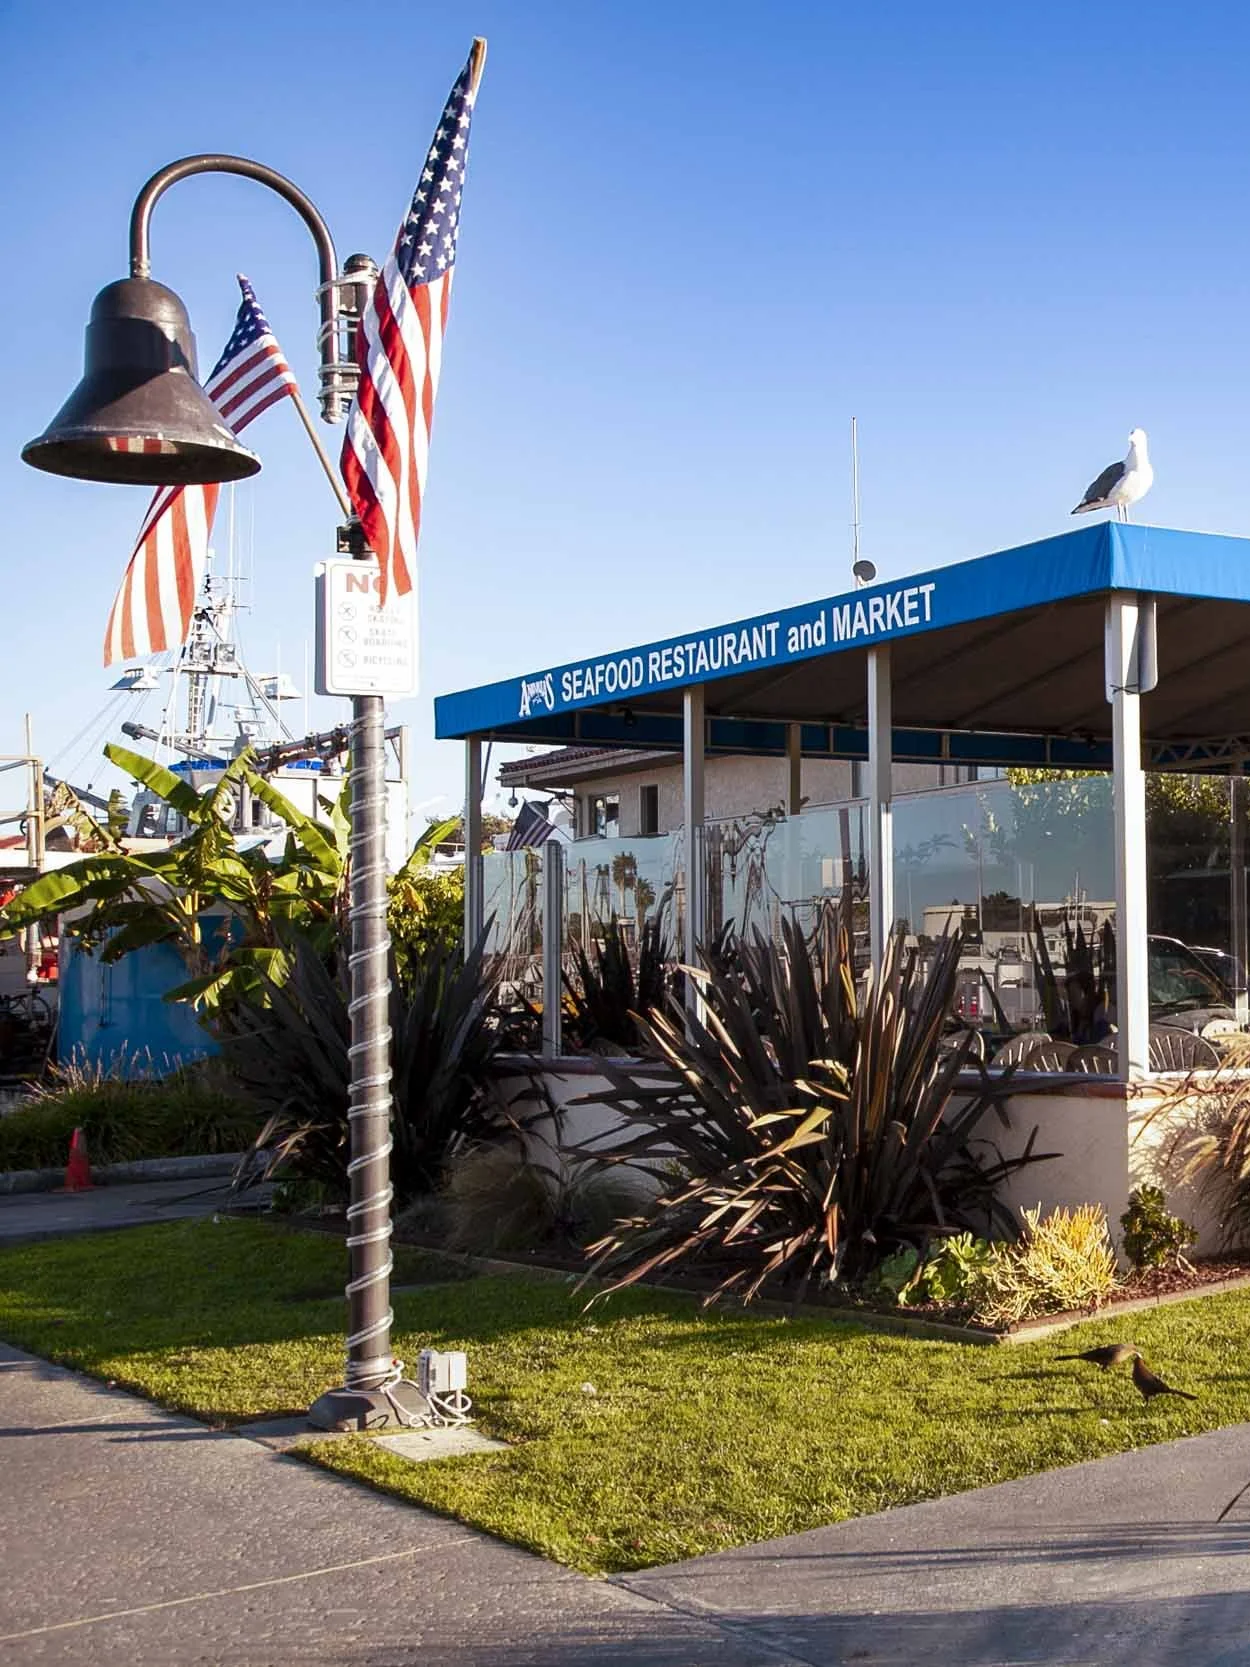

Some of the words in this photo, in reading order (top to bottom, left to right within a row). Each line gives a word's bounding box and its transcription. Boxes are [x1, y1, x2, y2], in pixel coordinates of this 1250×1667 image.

[561, 656, 644, 702] SEAFOOD
[648, 622, 780, 683] RESTAURANT
[787, 611, 826, 653] and
[832, 583, 936, 643] MARKET
